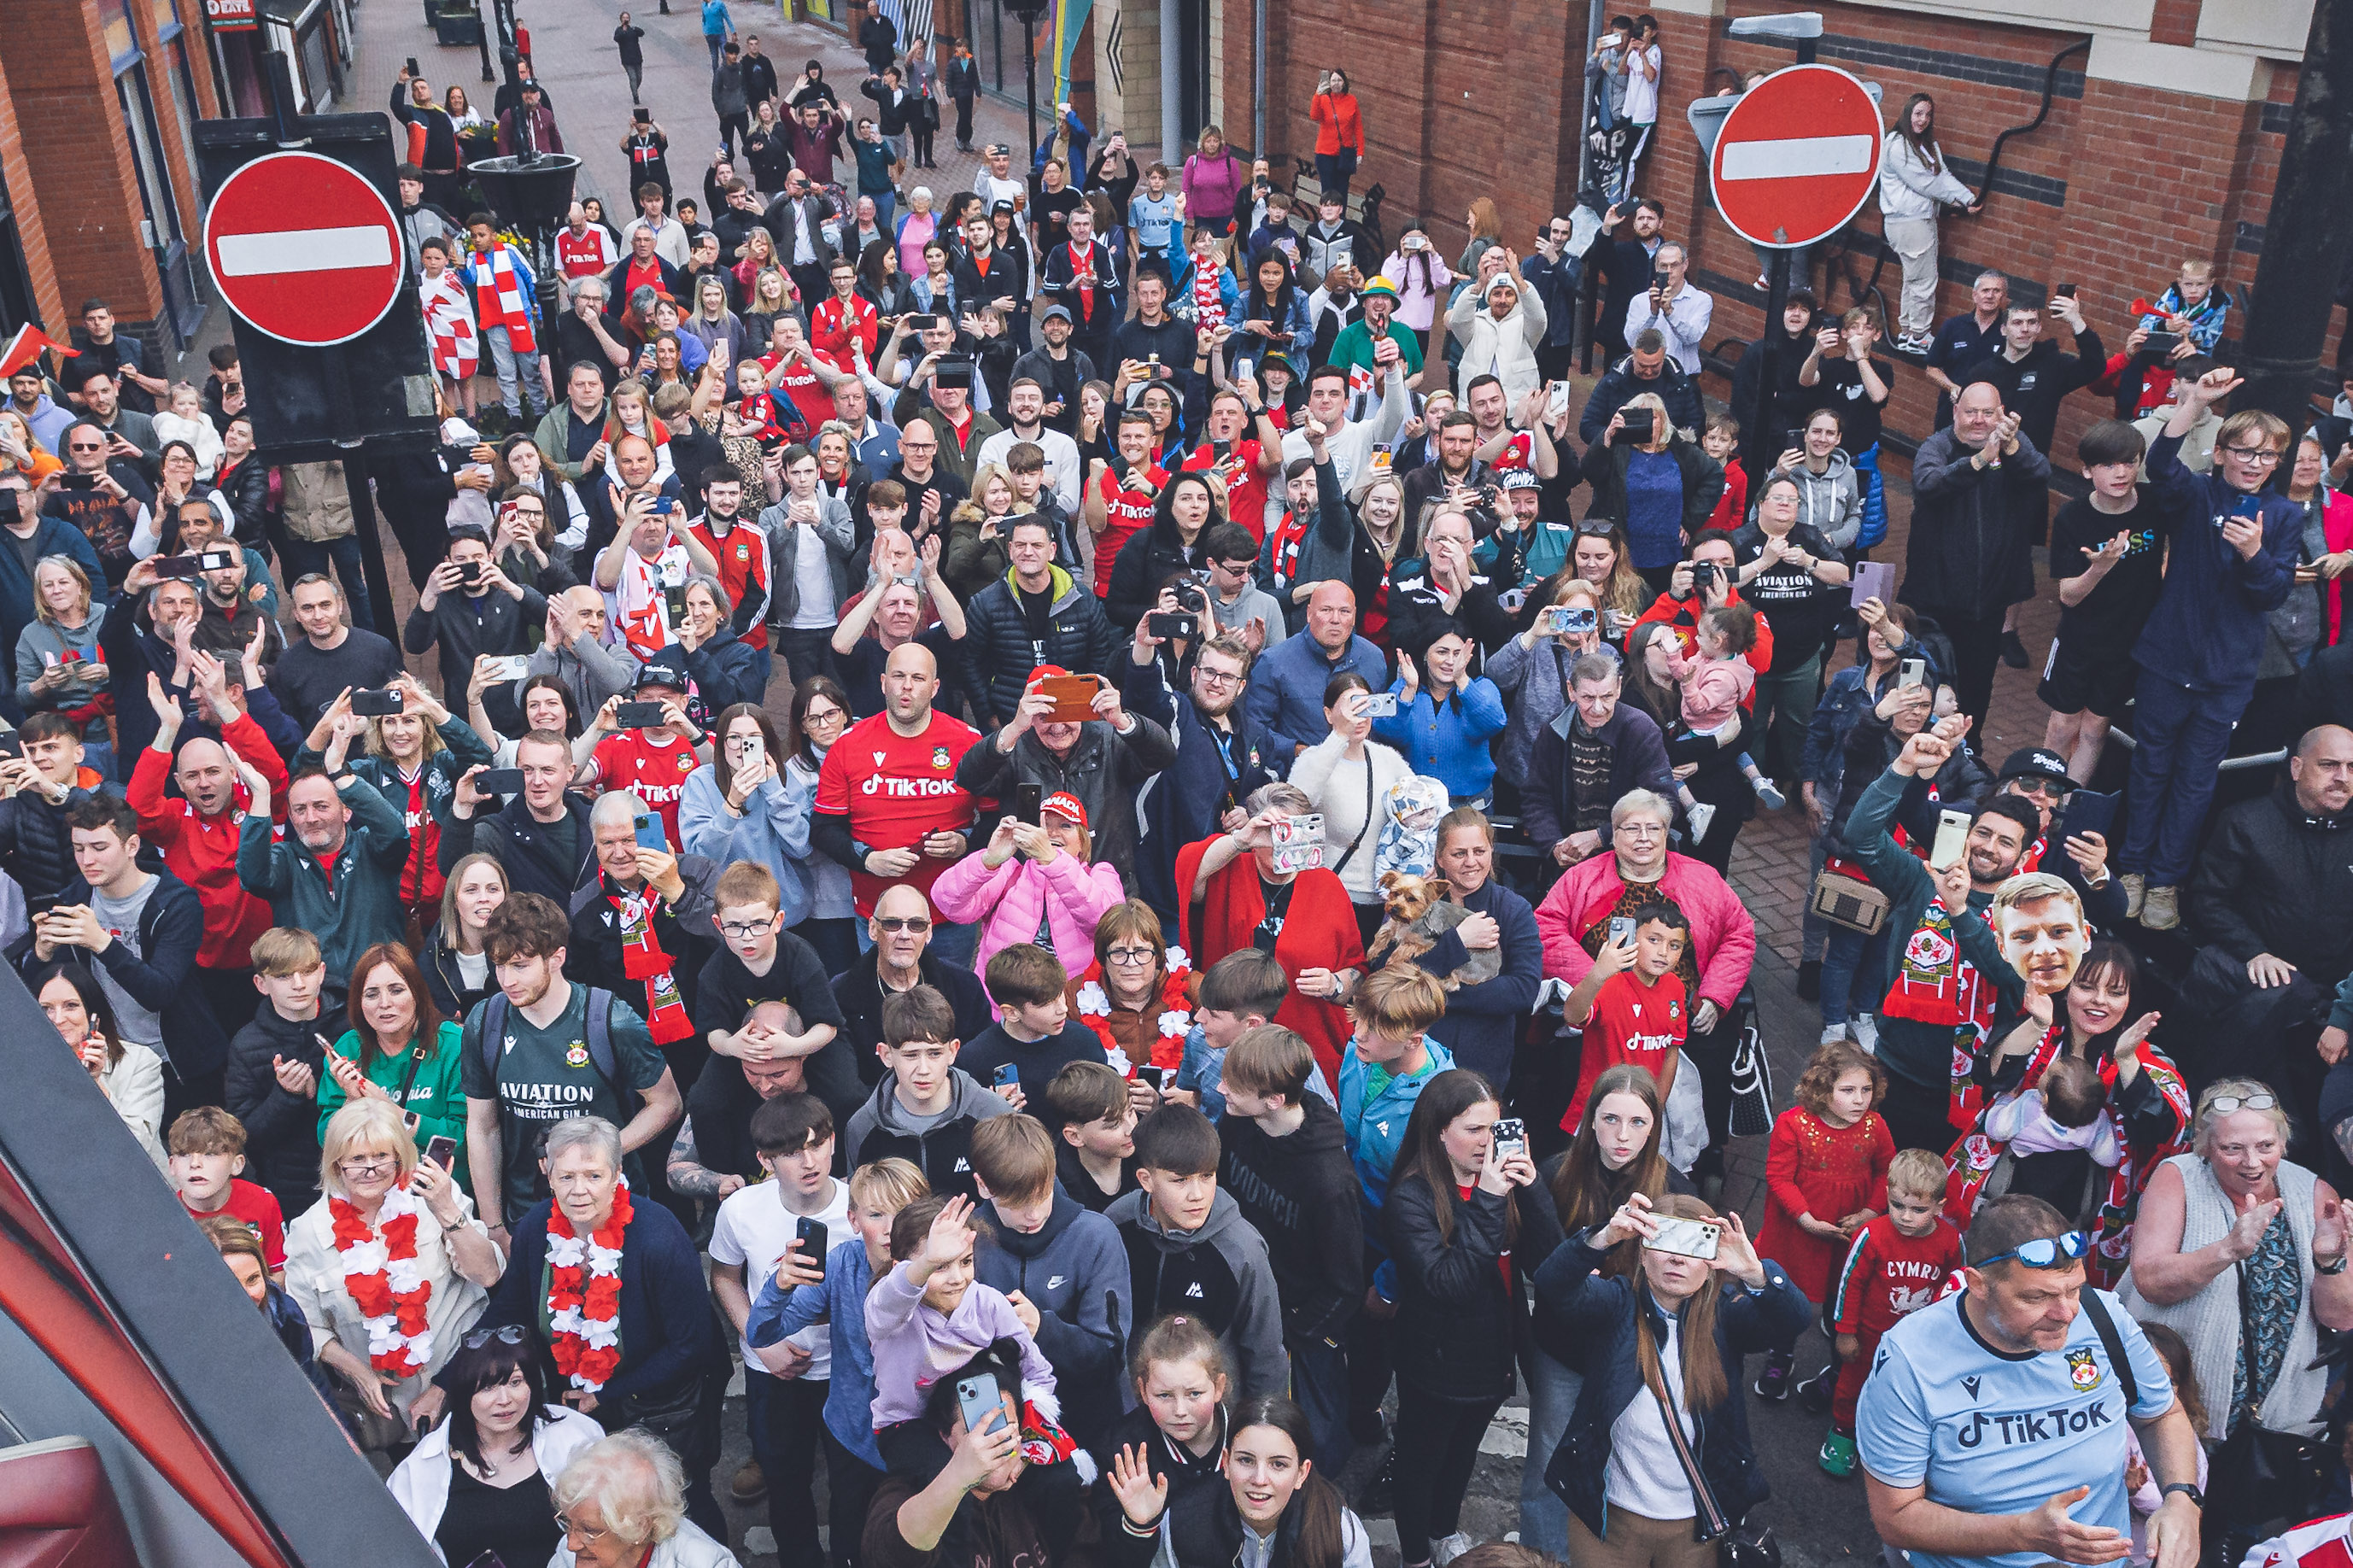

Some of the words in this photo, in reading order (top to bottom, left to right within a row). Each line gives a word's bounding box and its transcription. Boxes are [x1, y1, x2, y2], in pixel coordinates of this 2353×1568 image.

[787, 374, 817, 387] TikTok
[1755, 574, 1812, 588] AVIATION
[643, 783, 684, 802] TikT
[885, 778, 957, 796] TikTok
[500, 1082, 594, 1103] AVIATION
[513, 1107, 560, 1119] AMERICAN
[563, 1109, 581, 1119] GIN
[1887, 1261, 1940, 1281] CYMRU
[1994, 1401, 2112, 1446] TikTok
